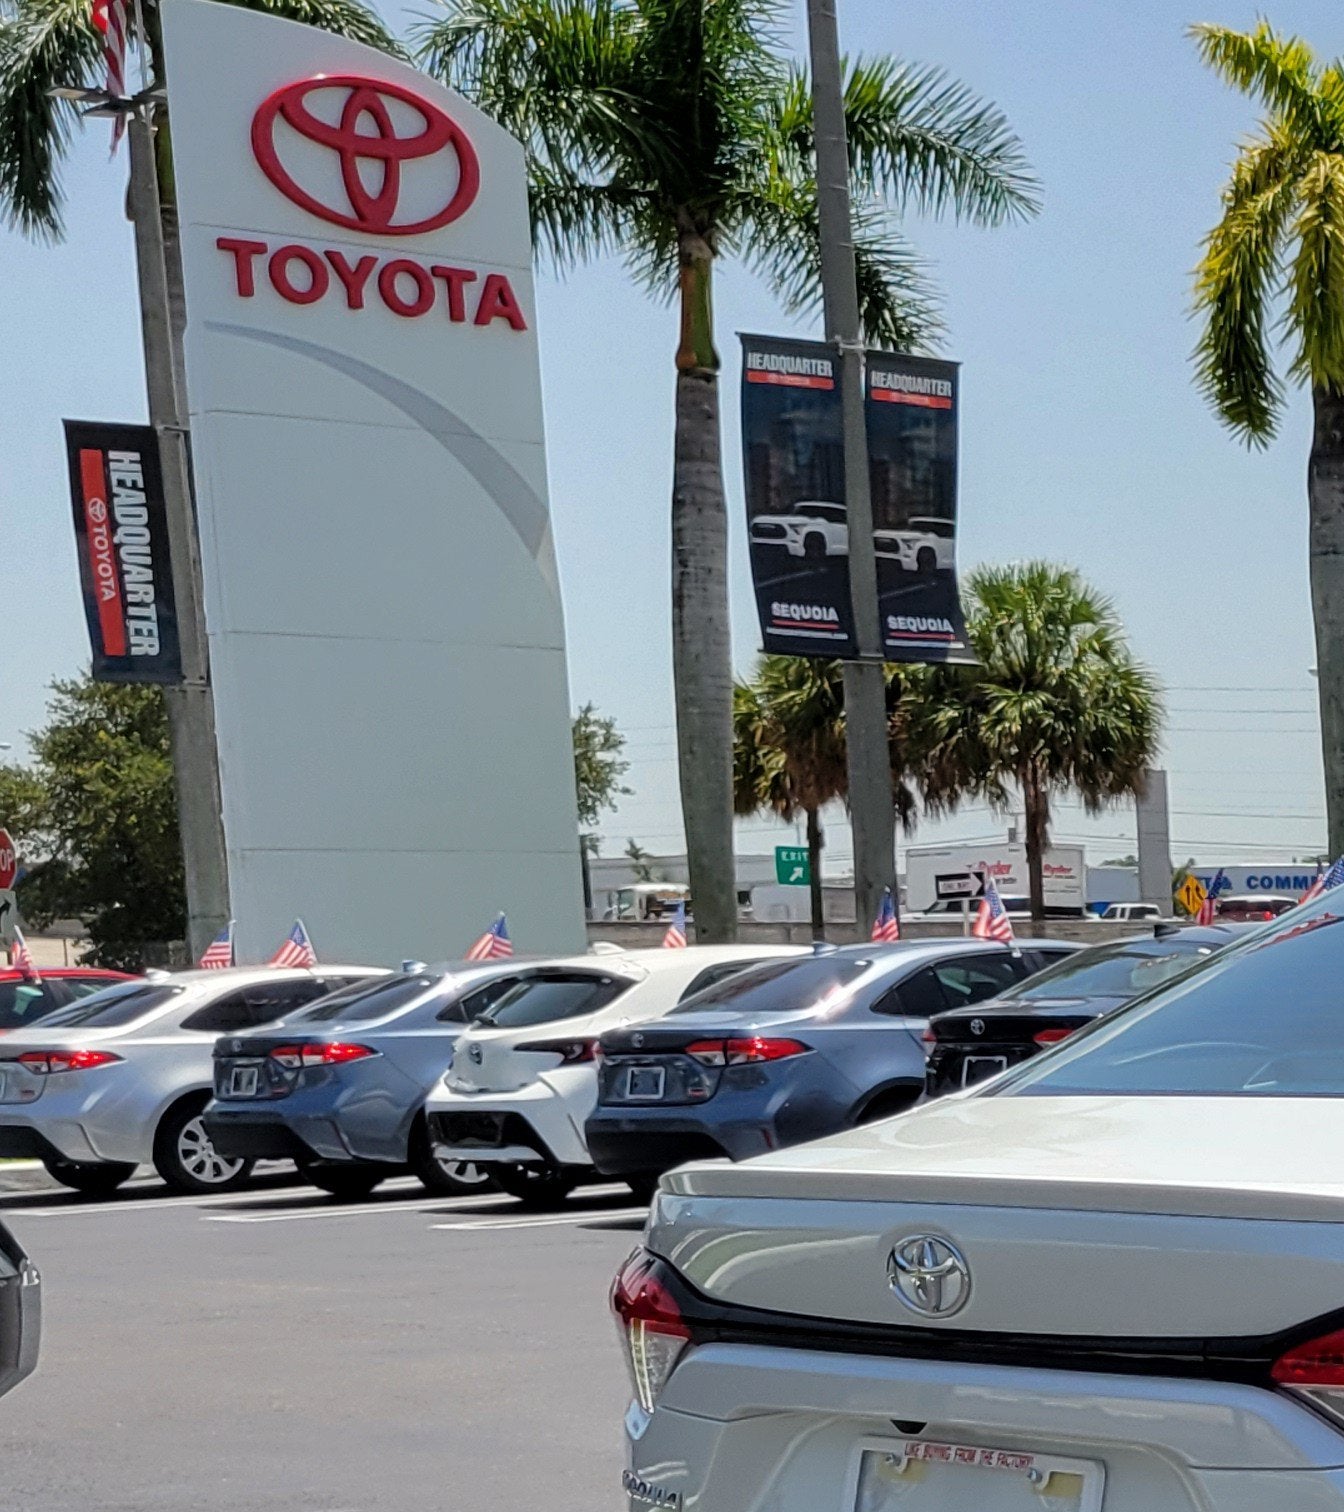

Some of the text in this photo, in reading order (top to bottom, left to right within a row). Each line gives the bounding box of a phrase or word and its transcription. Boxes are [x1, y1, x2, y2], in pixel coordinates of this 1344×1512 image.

[216, 237, 528, 331] TOYOTA
[747, 352, 834, 378] HEADQUARTER
[871, 370, 952, 397] HEADQUARTER
[92, 527, 117, 601] TOYOTA
[108, 450, 160, 657] HEADQUARTER
[771, 601, 840, 622] SEQUOIA
[887, 615, 955, 633] SEQUOIA
[0, 848, 14, 871] OP
